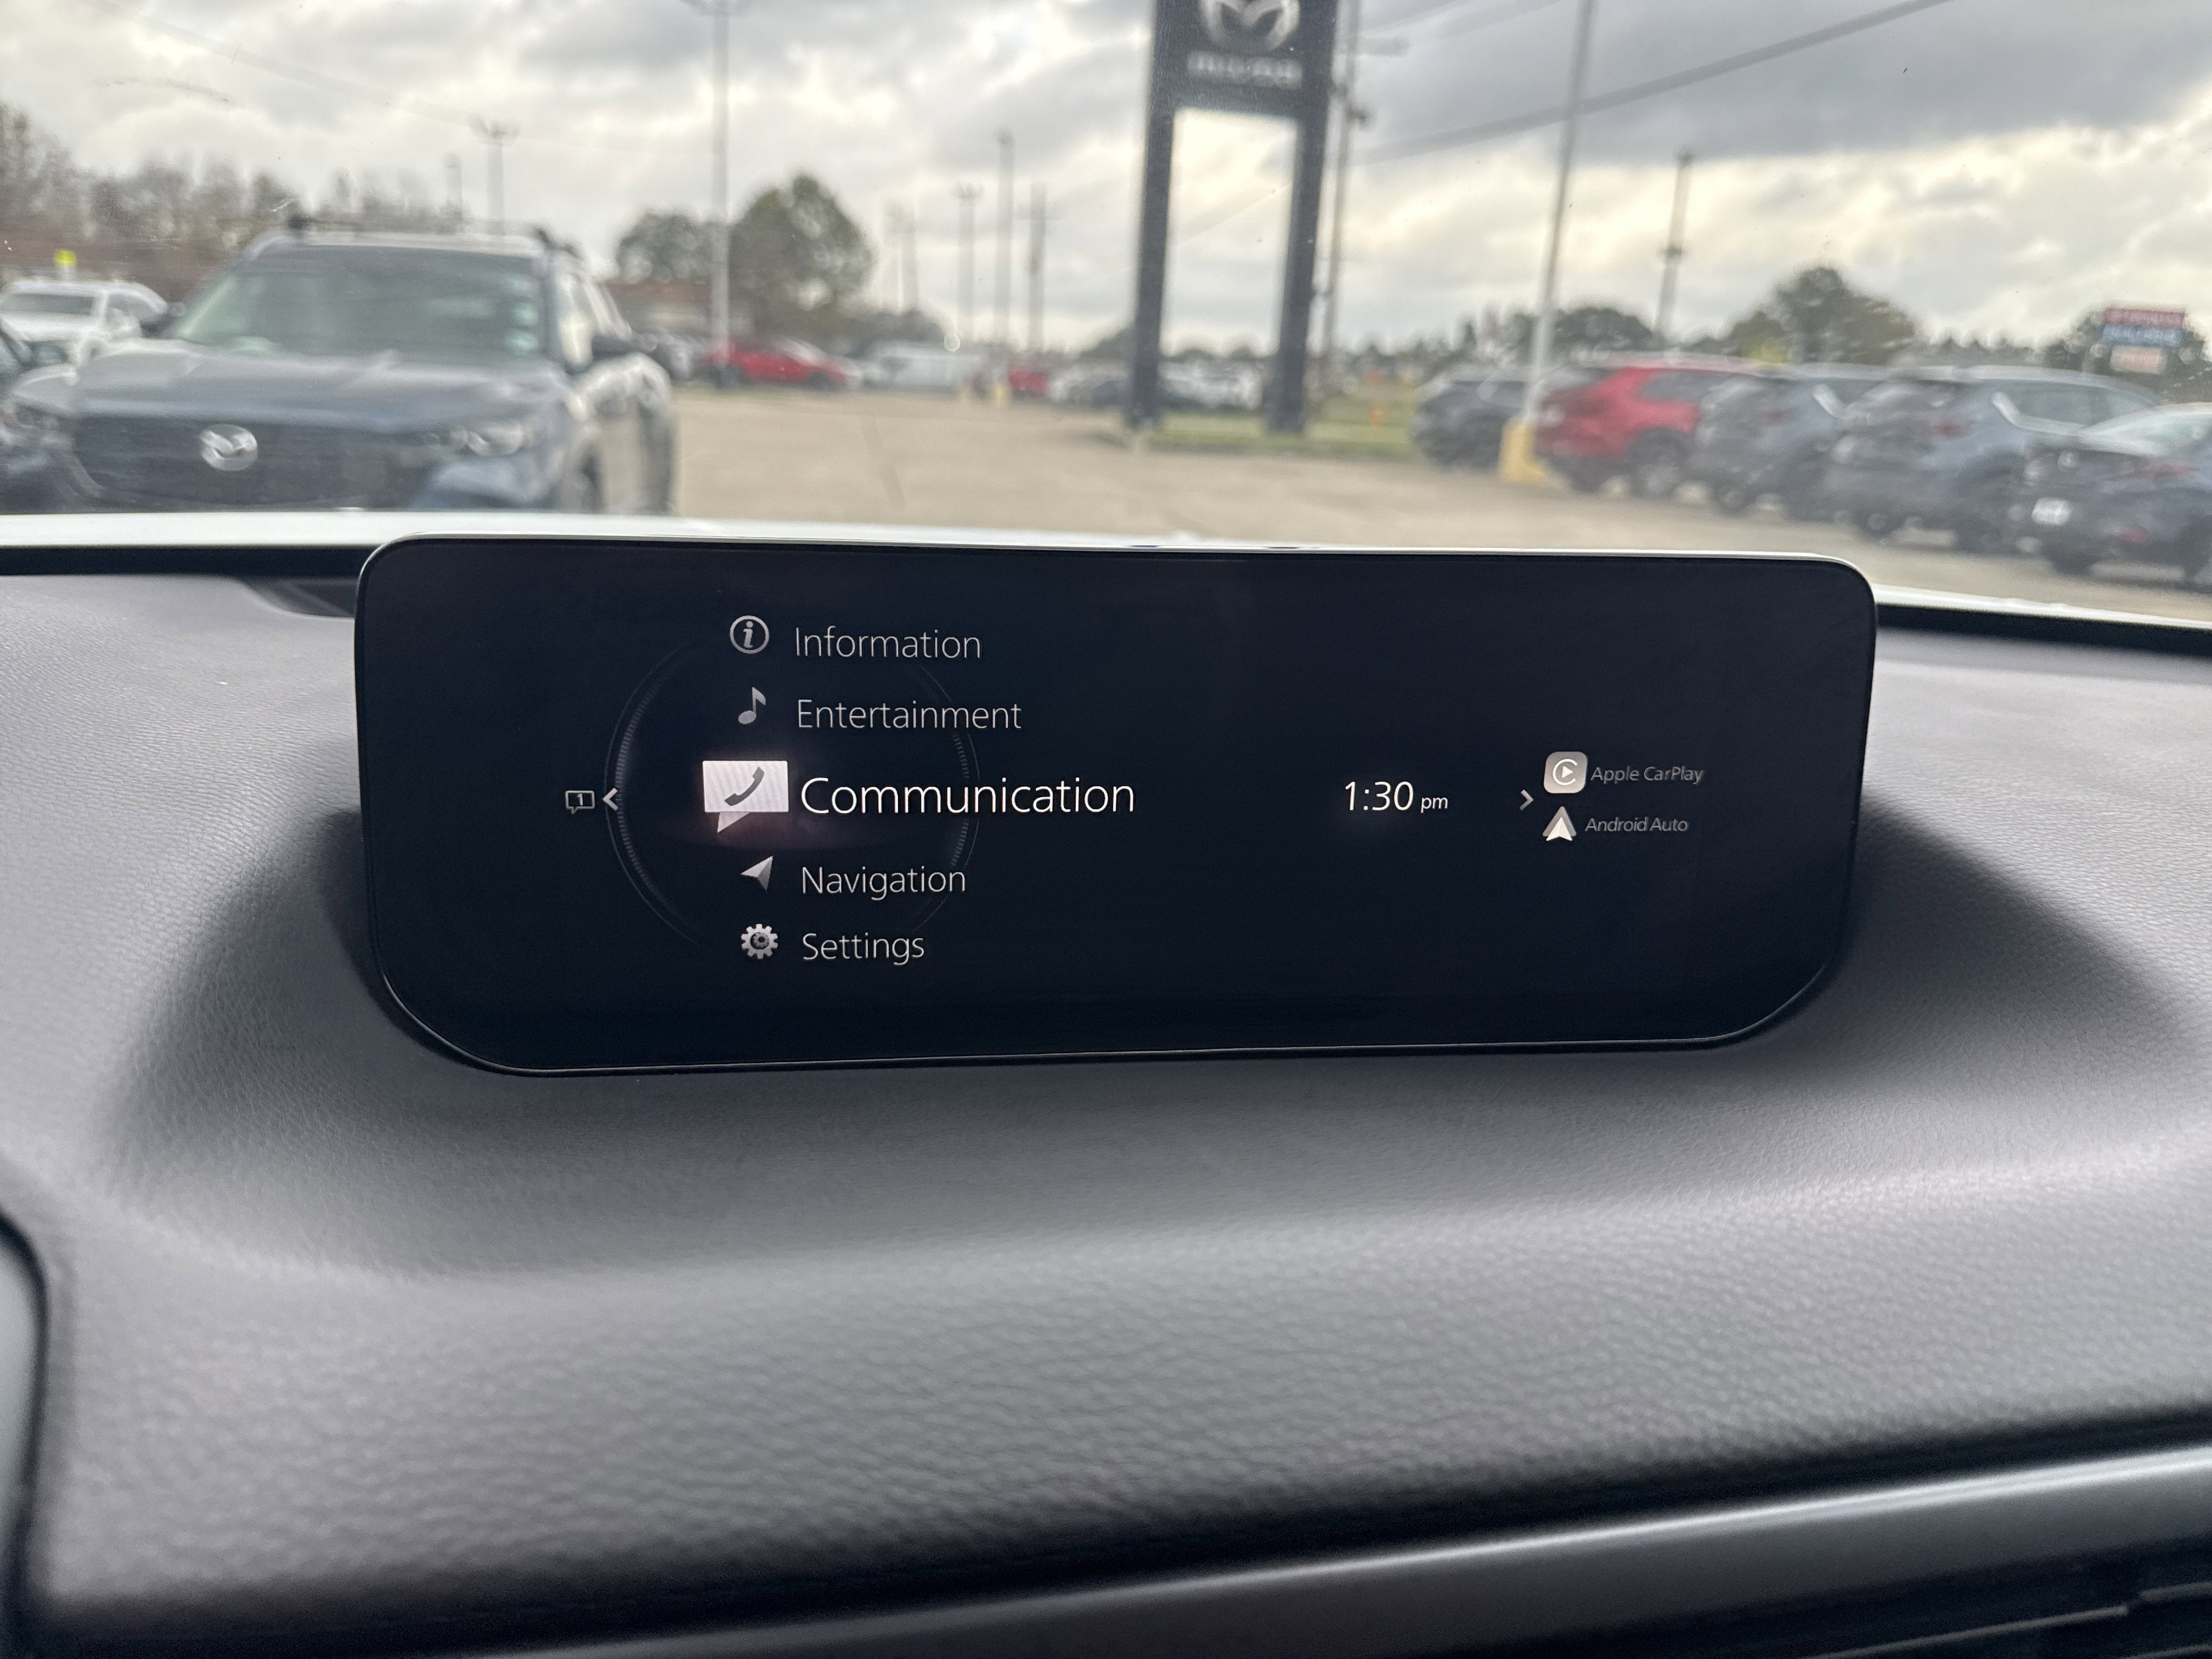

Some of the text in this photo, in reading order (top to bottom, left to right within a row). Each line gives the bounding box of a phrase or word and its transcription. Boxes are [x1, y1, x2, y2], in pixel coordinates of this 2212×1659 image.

[796, 625, 980, 658] Information
[798, 699, 1022, 729] Entertainment
[1590, 765, 1703, 785] Apple CarPlay
[801, 777, 1133, 814] Communication
[1345, 781, 1448, 814] 1:30 pm
[1584, 816, 1688, 832] Android Auto
[802, 865, 966, 901] Navigation
[803, 932, 924, 966] Settings
